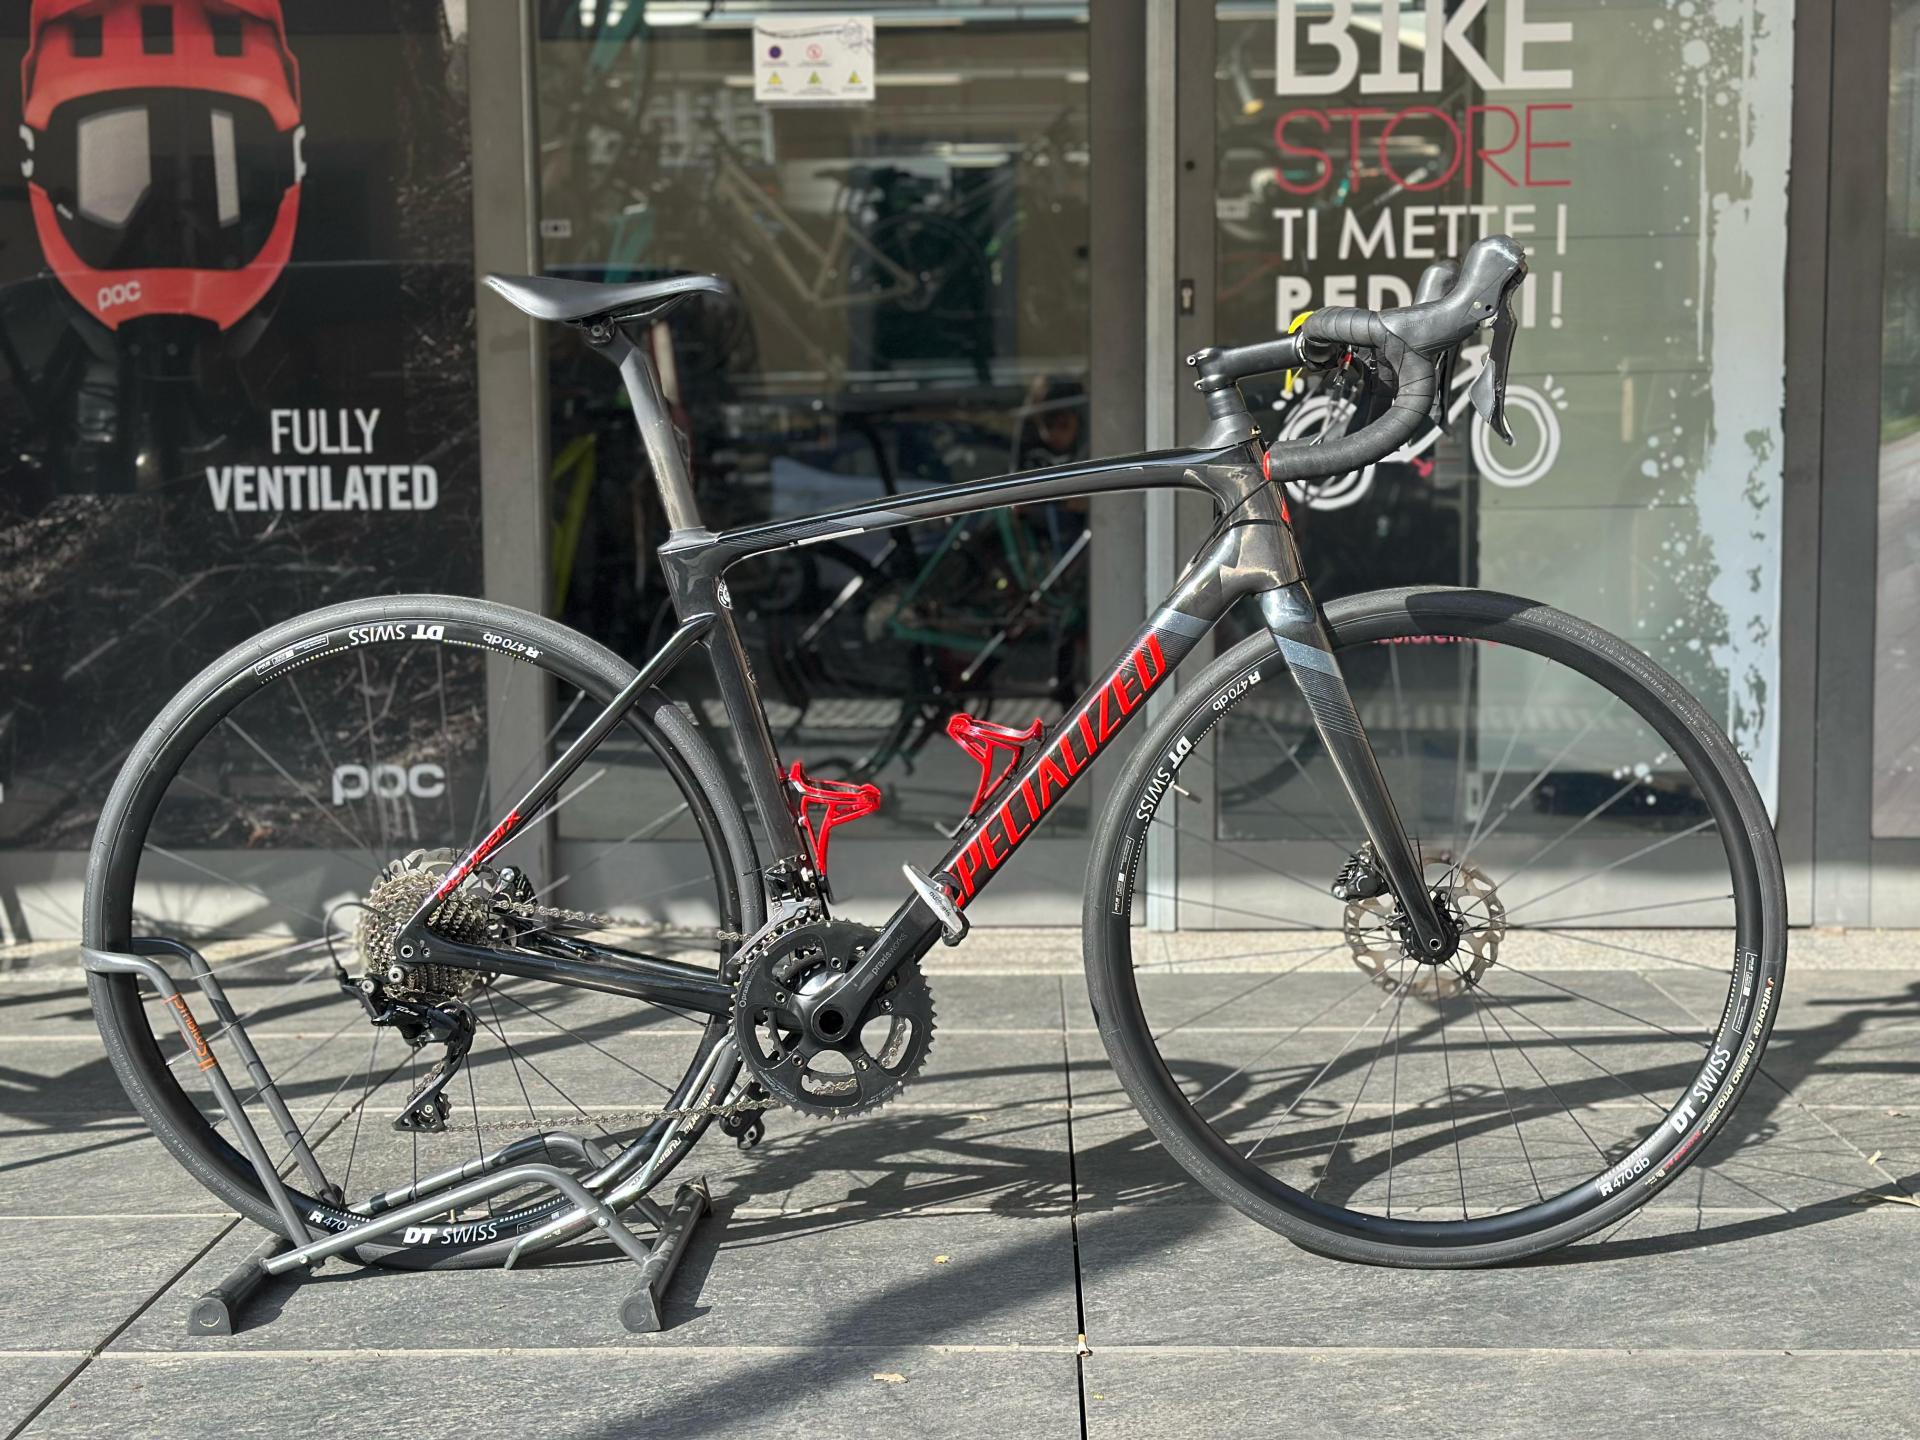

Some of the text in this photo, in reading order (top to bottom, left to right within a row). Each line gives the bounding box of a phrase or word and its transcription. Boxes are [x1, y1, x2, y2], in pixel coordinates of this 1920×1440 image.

[1275, 0, 1573, 95] BIKE
[1274, 103, 1574, 194] STORE
[1273, 203, 1568, 260] TI METTE I
[97, 280, 142, 312] poc
[270, 408, 380, 454] FULLY
[205, 464, 438, 512] VENTILATED
[348, 624, 445, 646] DT SWISS
[332, 762, 446, 806] poc
[1136, 735, 1192, 823] DT SWISS
[1731, 1040, 1756, 1085] RUBINO
[1670, 1097, 1697, 1134] DT
[1692, 1044, 1731, 1104] SWISS
[1717, 1084, 1734, 1111] PRO
[403, 1222, 498, 1245] DT SWISS
